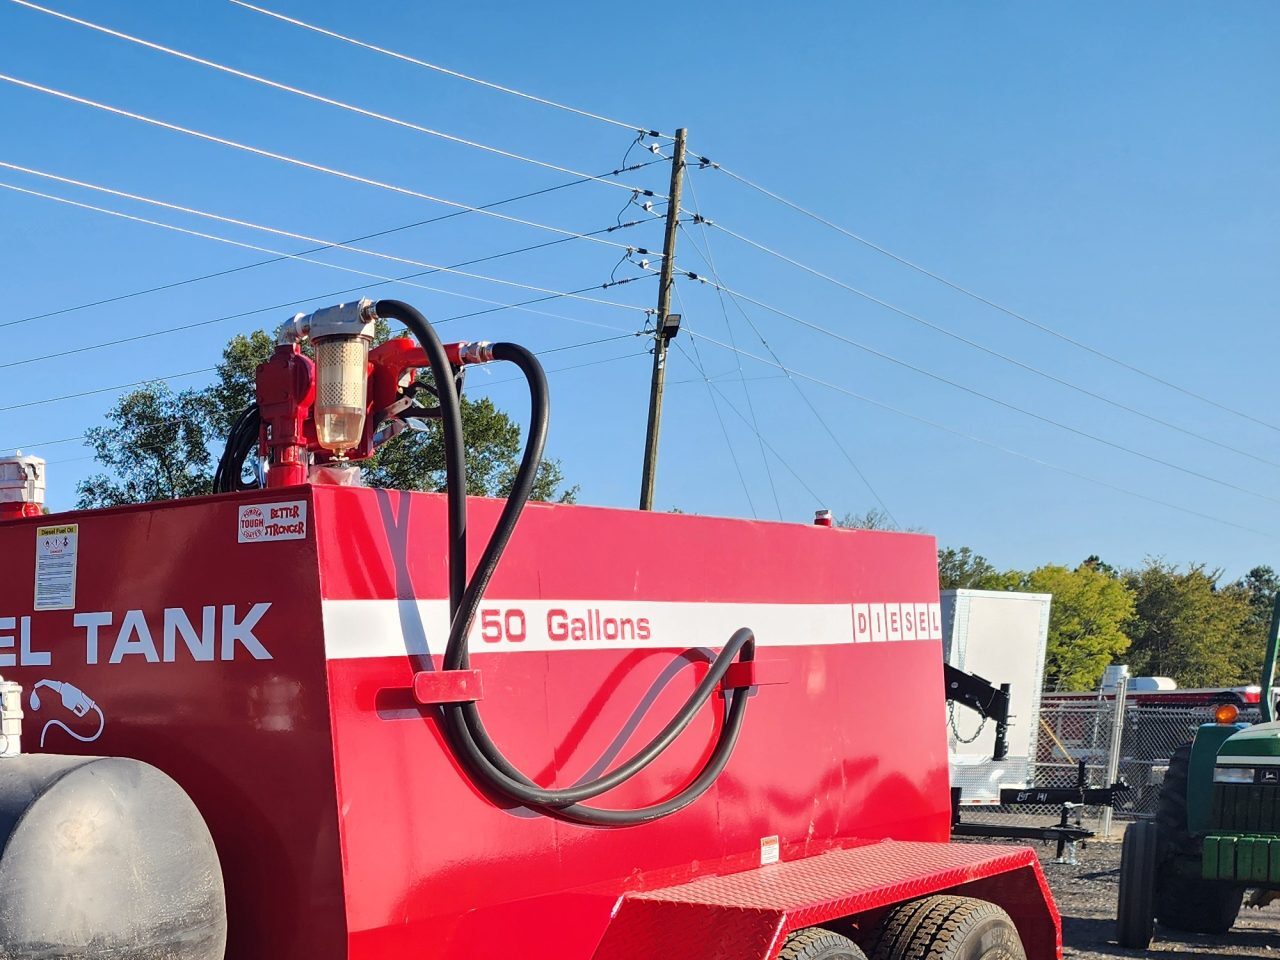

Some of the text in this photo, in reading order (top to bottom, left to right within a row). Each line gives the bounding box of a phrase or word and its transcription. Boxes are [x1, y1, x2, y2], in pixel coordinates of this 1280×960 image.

[270, 505, 300, 519] BETTER
[241, 519, 264, 528] TOUGH
[264, 521, 305, 536] STRONGER
[546, 608, 651, 642] Gallons
[857, 612, 939, 633] DIESEL
[73, 602, 274, 664] TANK
